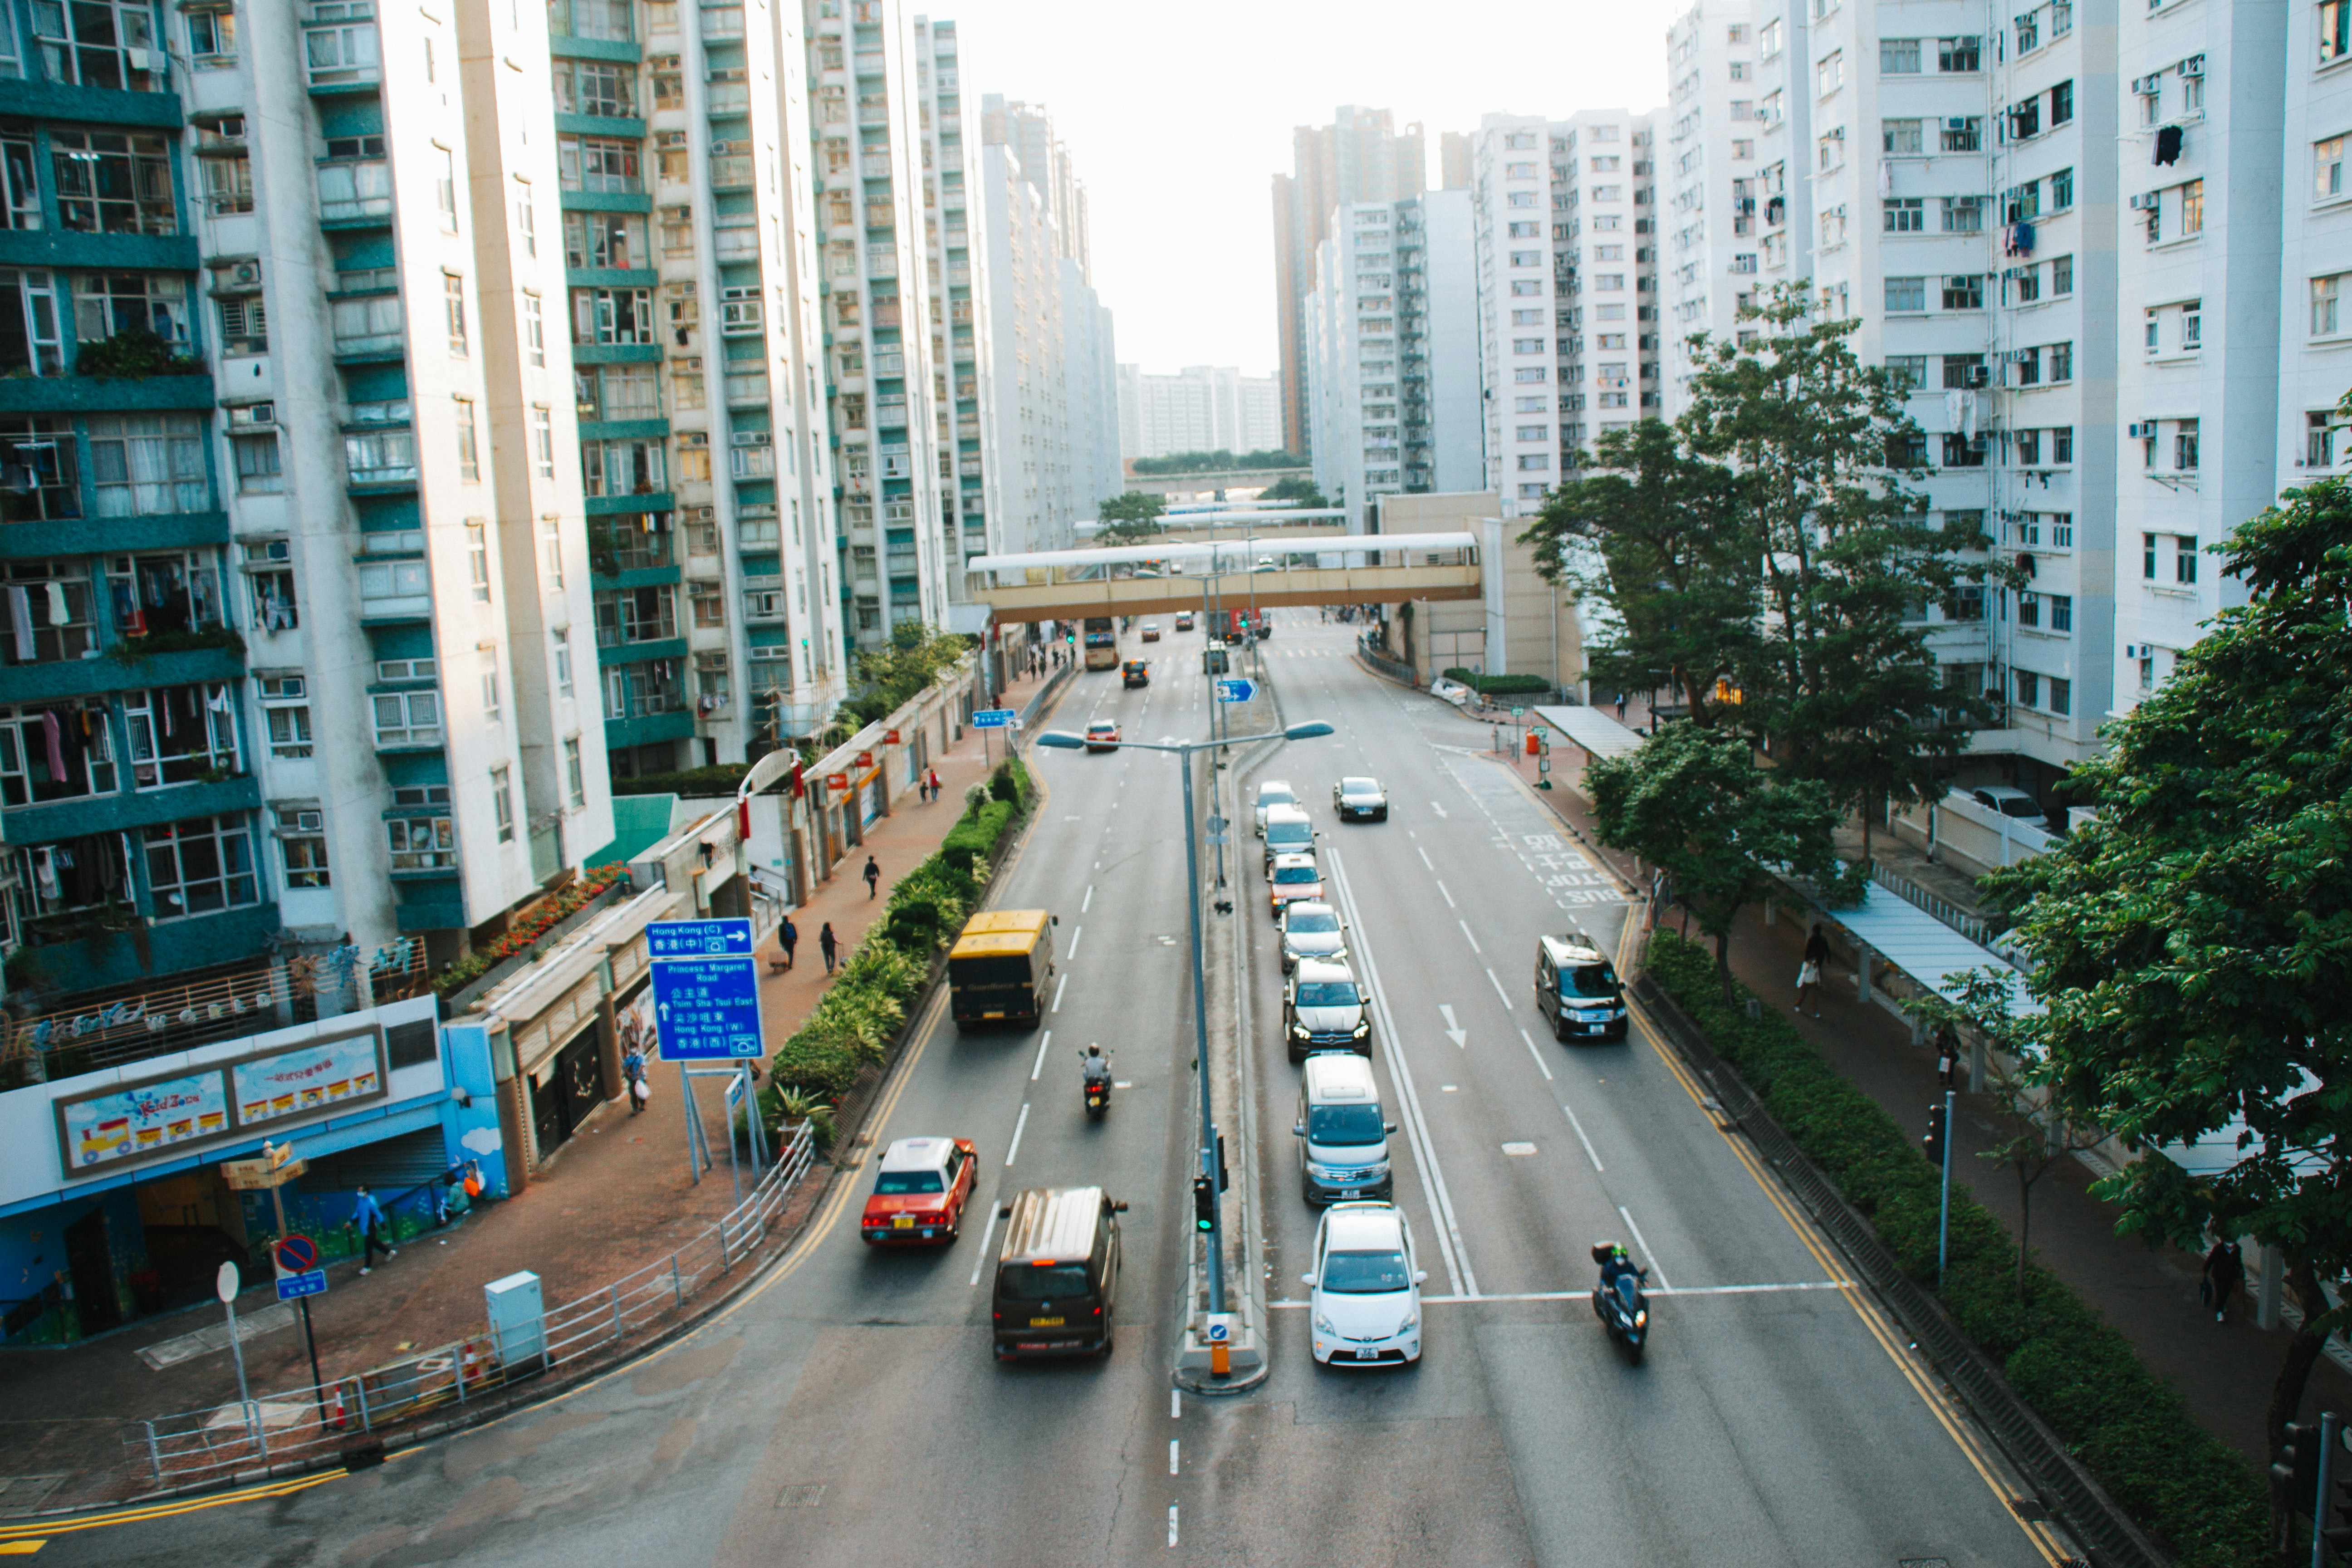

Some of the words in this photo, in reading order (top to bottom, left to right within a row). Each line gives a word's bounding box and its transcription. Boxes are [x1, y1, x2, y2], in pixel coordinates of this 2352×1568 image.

[1534, 852, 1593, 870] 巴士
[1547, 873, 1617, 887] STOP
[1565, 889, 1626, 903] BUS
[652, 927, 676, 936] Hong
[678, 926, 701, 936] Kong
[704, 926, 720, 934] (C)
[654, 938, 702, 950] 香港(中)
[668, 965, 704, 974] Princess
[709, 963, 746, 974] Margaret
[696, 974, 718, 982] Road
[671, 987, 708, 998] 公主道
[672, 1000, 691, 1008] Tsim
[696, 999, 711, 1007] Sha
[715, 998, 731, 1006] Tsui
[735, 998, 753, 1006] East
[674, 1026, 696, 1034] Hong
[701, 1024, 722, 1034] Kong
[726, 1023, 743, 1032] (W)
